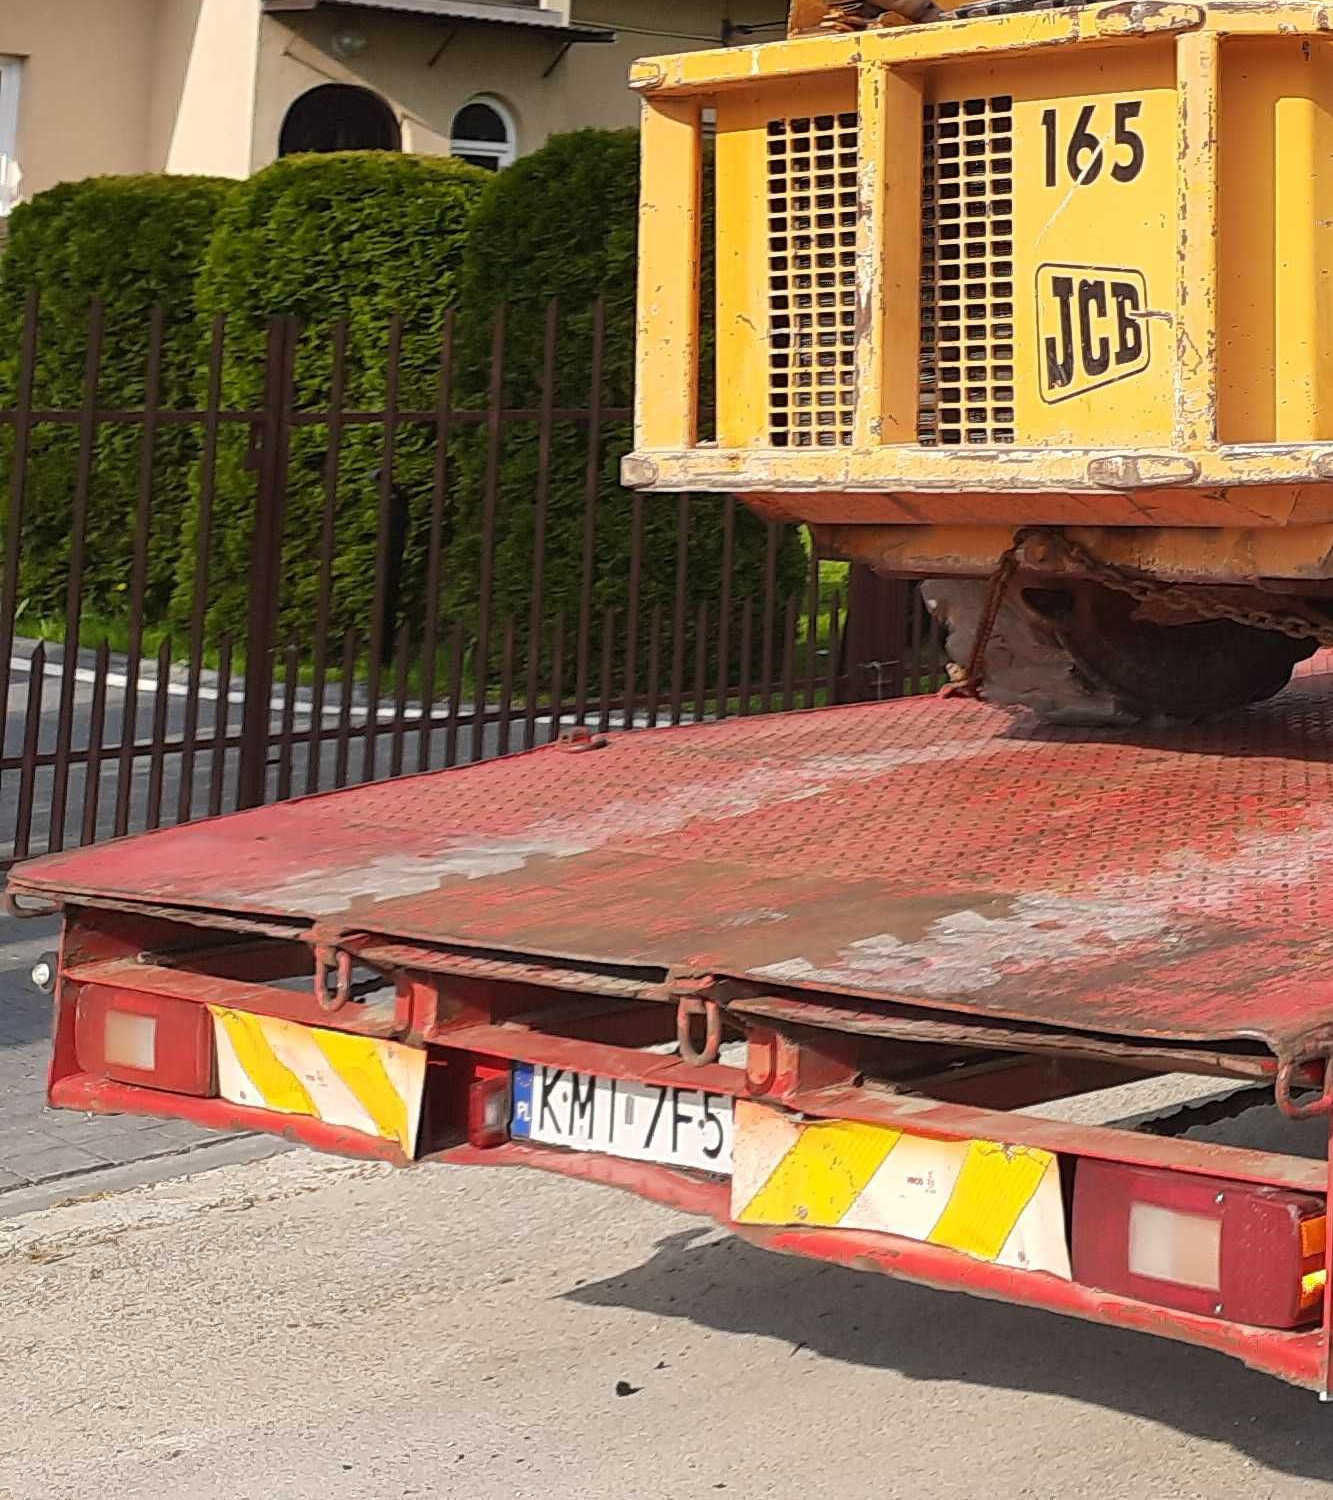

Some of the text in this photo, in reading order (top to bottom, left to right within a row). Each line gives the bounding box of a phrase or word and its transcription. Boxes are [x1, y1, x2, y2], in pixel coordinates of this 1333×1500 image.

[1040, 100, 1145, 188] 165
[1044, 275, 1143, 391] JCB
[644, 1083, 734, 1161] 7F5
